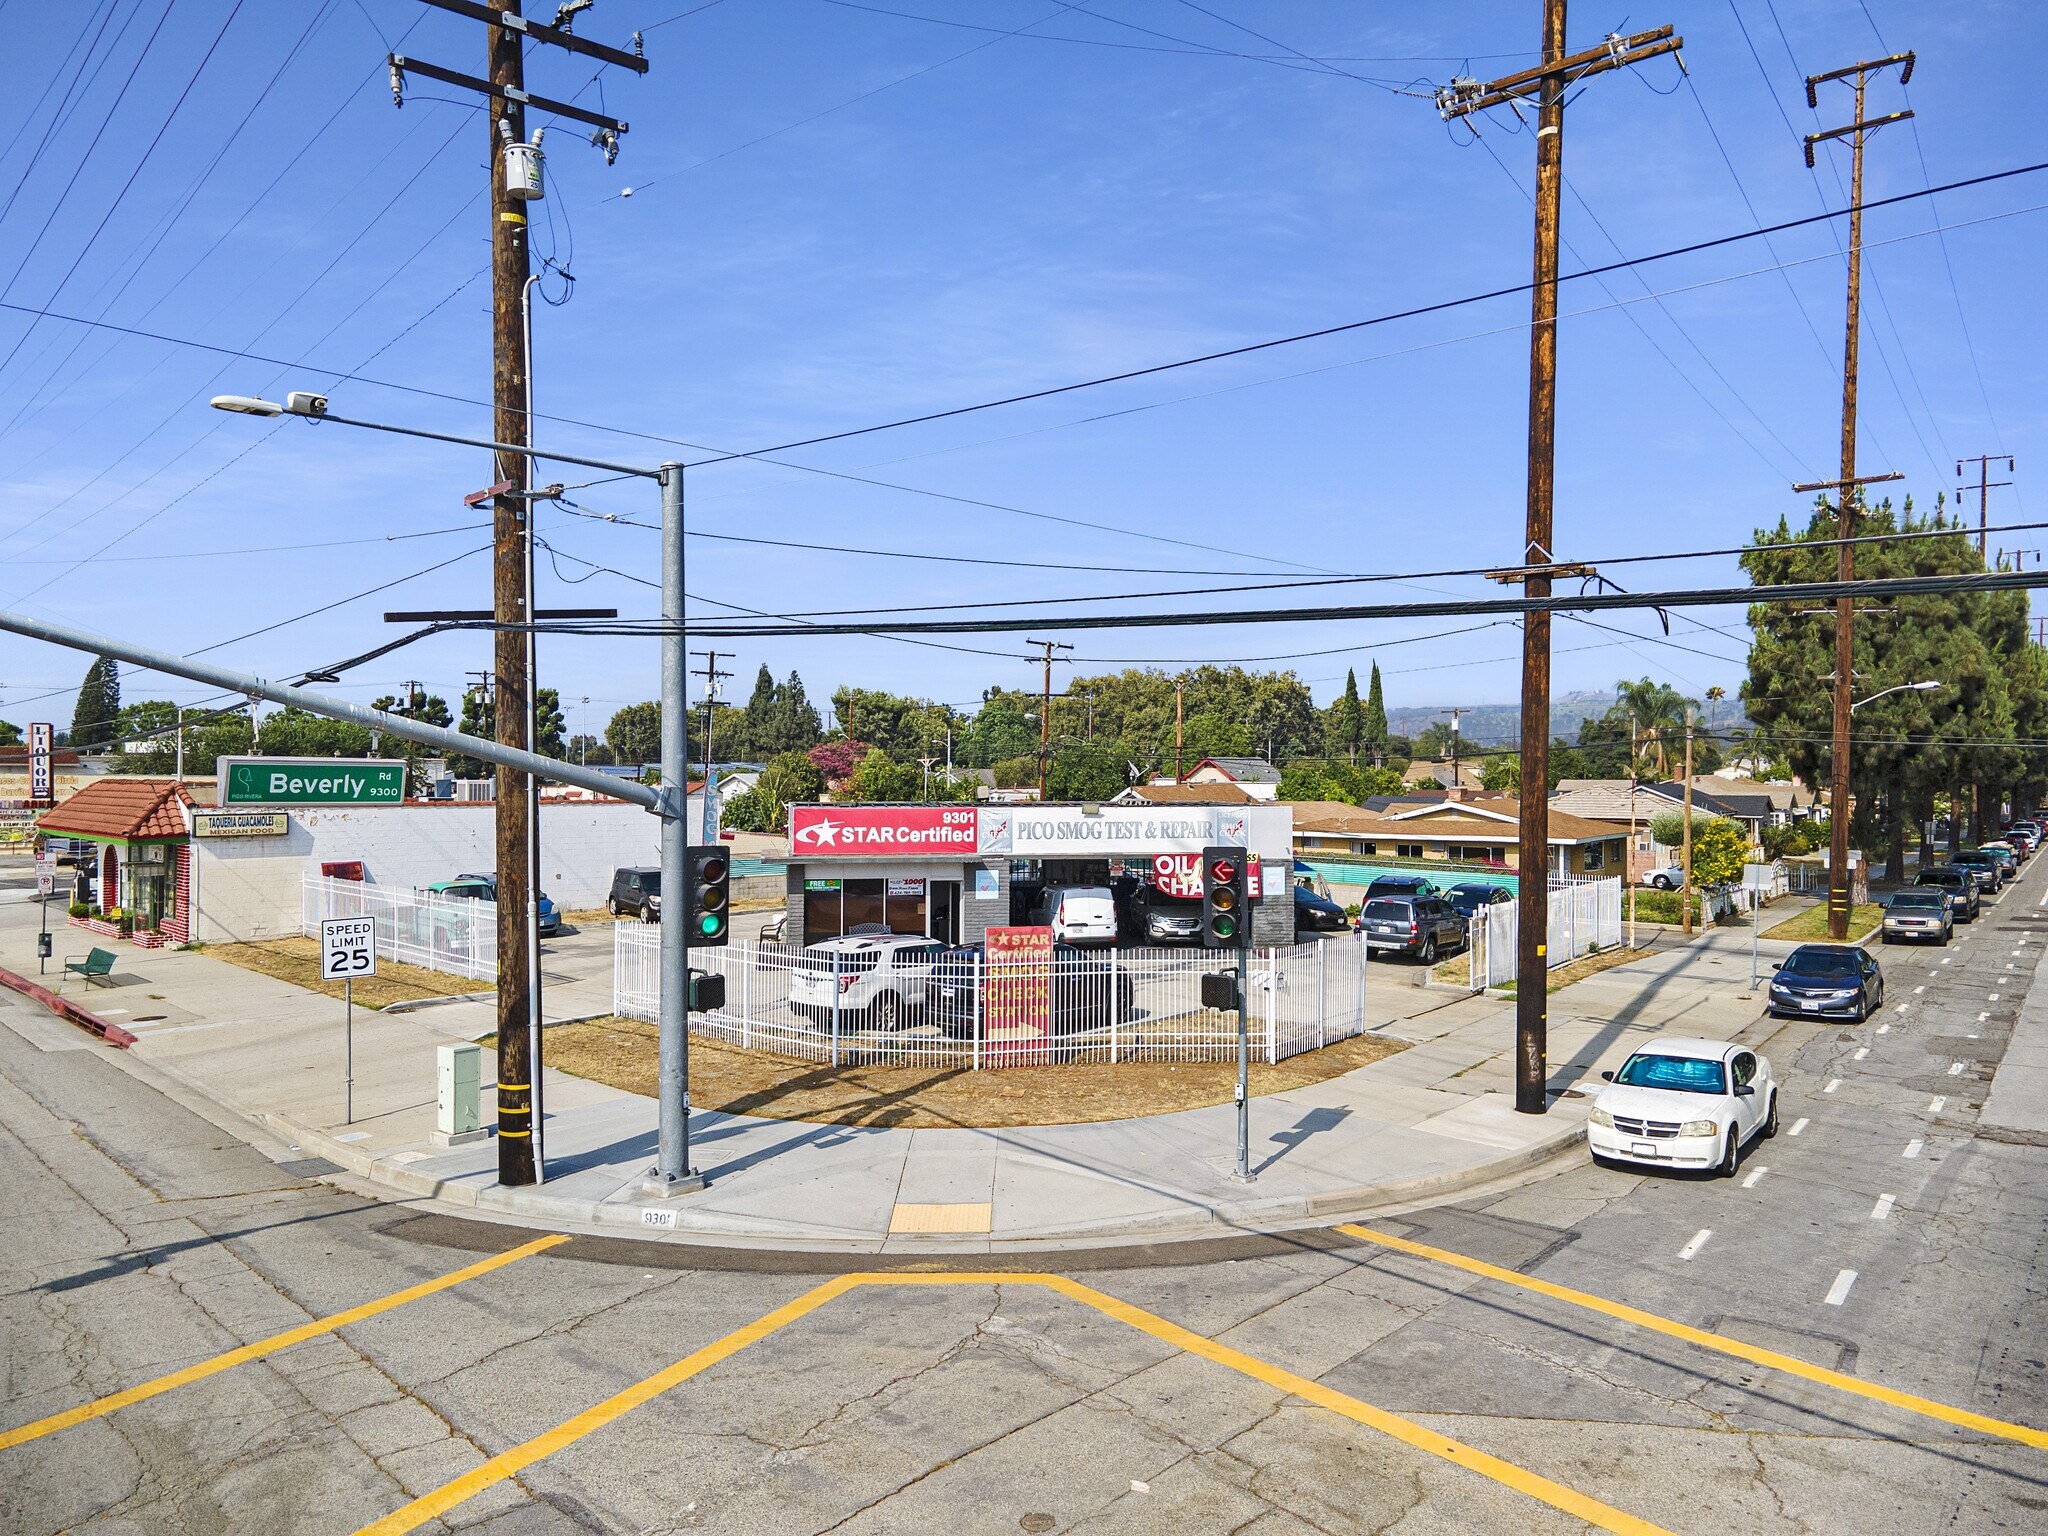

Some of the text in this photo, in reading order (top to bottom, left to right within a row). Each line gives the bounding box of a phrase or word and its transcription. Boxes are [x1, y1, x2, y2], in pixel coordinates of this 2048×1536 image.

[35, 726, 47, 787] LIQUOR
[379, 772, 392, 780] Rd
[269, 773, 366, 798] Beverly
[370, 788, 398, 796] 9300
[706, 784, 718, 834] SMOG
[209, 816, 274, 830] TAQUERIA GUACAMOLES
[942, 812, 974, 824] 9301
[841, 826, 974, 843] STAR Certified
[982, 831, 1010, 840] CHECK
[1017, 820, 1214, 840] PICO SMOG TEST & REPAIR
[1220, 829, 1246, 838] CHECK
[1155, 856, 1193, 874] OIL
[1158, 876, 1260, 896] CHAE
[326, 924, 371, 936] SPEED
[332, 936, 366, 948] LIMIT
[1011, 934, 1050, 946] STAR
[330, 948, 370, 972] 25
[988, 946, 1050, 960] Certified
[988, 986, 1049, 1002] CHECK
[988, 1005, 1048, 1018] STATION
